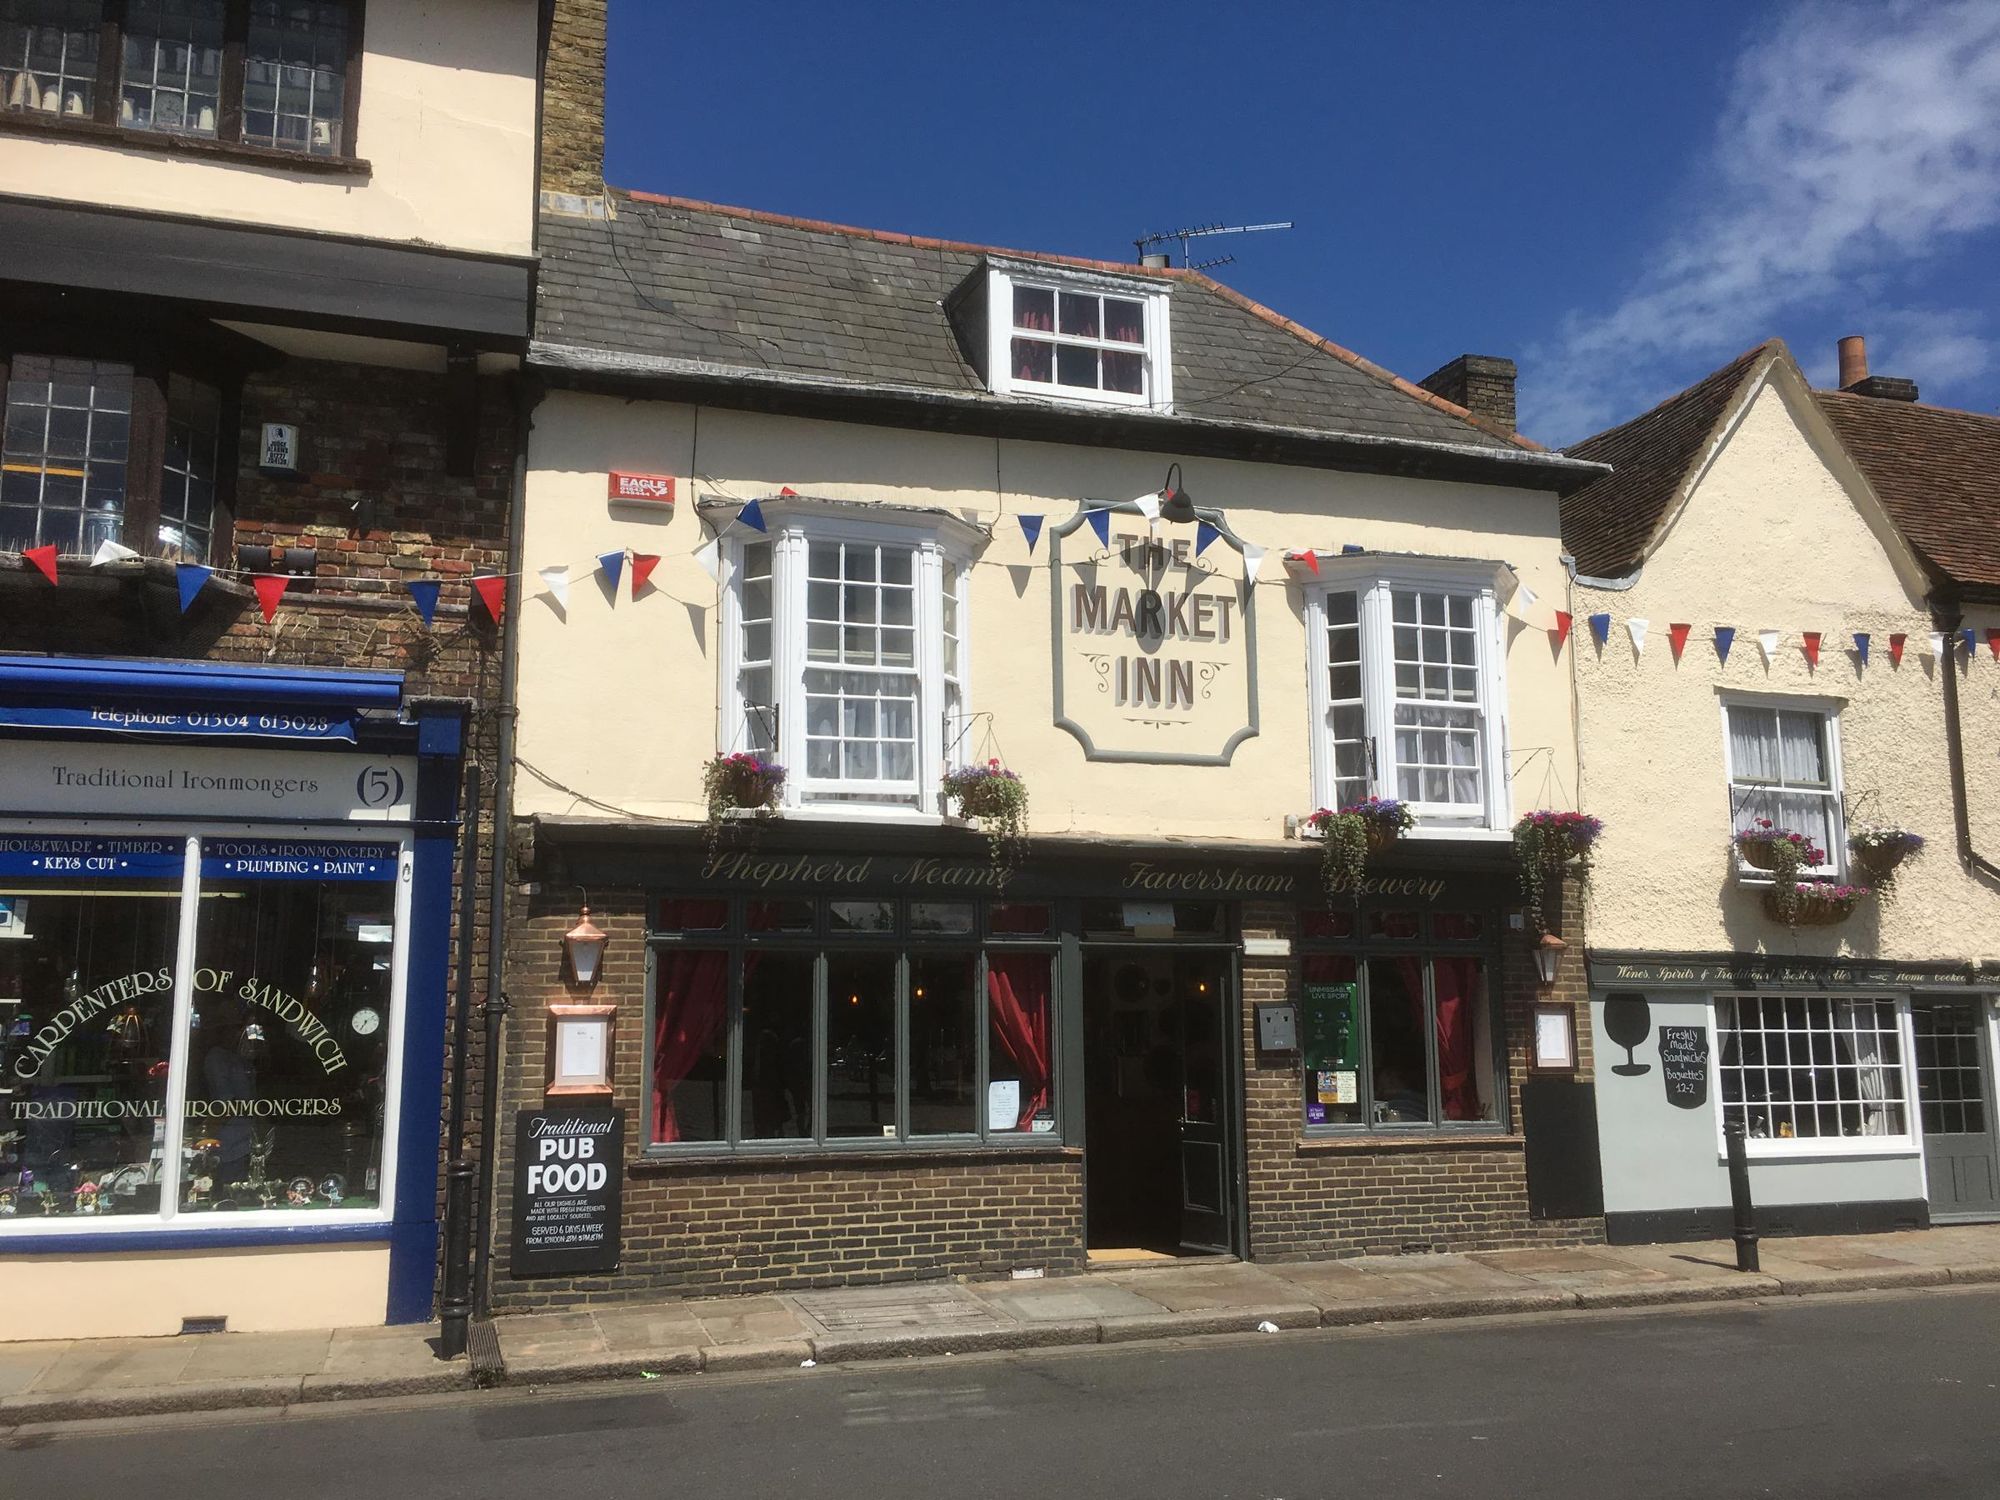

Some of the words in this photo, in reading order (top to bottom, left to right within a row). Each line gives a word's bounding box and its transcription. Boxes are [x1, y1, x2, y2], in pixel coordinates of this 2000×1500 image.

[620, 477, 667, 489] EAGLE
[1112, 533, 1191, 573] THE
[1069, 583, 1238, 644] MARKET
[1115, 655, 1194, 711] INN
[187, 711, 249, 727] 01304
[259, 714, 329, 731] 613028
[52, 766, 173, 789] Traditional
[183, 770, 319, 798] Ironmongers
[0, 840, 92, 853] HOUSEWARE
[107, 841, 162, 854] TIMBER
[216, 843, 268, 855] TOOLS
[278, 845, 386, 859] IRONMONGERY
[44, 857, 81, 870] KEYS
[86, 857, 117, 870] CUT
[236, 860, 309, 873] PLUMBING
[323, 862, 365, 874] PAINT
[701, 852, 873, 888] Shepherd
[893, 857, 1014, 887] Neame
[1122, 861, 1296, 893] Faversham
[1656, 967, 1694, 982] Spirits
[14, 966, 173, 1079] CARPENTERS
[193, 968, 234, 993] OF
[239, 977, 348, 1076] SANDWICH
[1666, 1028, 1698, 1043] Freshly
[1670, 1040, 1695, 1051] Made
[1676, 1083, 1695, 1094] 12-2
[11, 1100, 164, 1120] TRADITIONAL
[184, 1097, 342, 1118] IRONMONGERS
[528, 1116, 615, 1139] Traditional
[539, 1137, 595, 1162] PUB
[527, 1163, 607, 1195] FOOD
[532, 1226, 558, 1235] SERVED
[559, 1225, 564, 1233] 6
[565, 1224, 581, 1233] DAYS
[581, 1224, 586, 1232] A
[586, 1223, 604, 1233] WEEK
